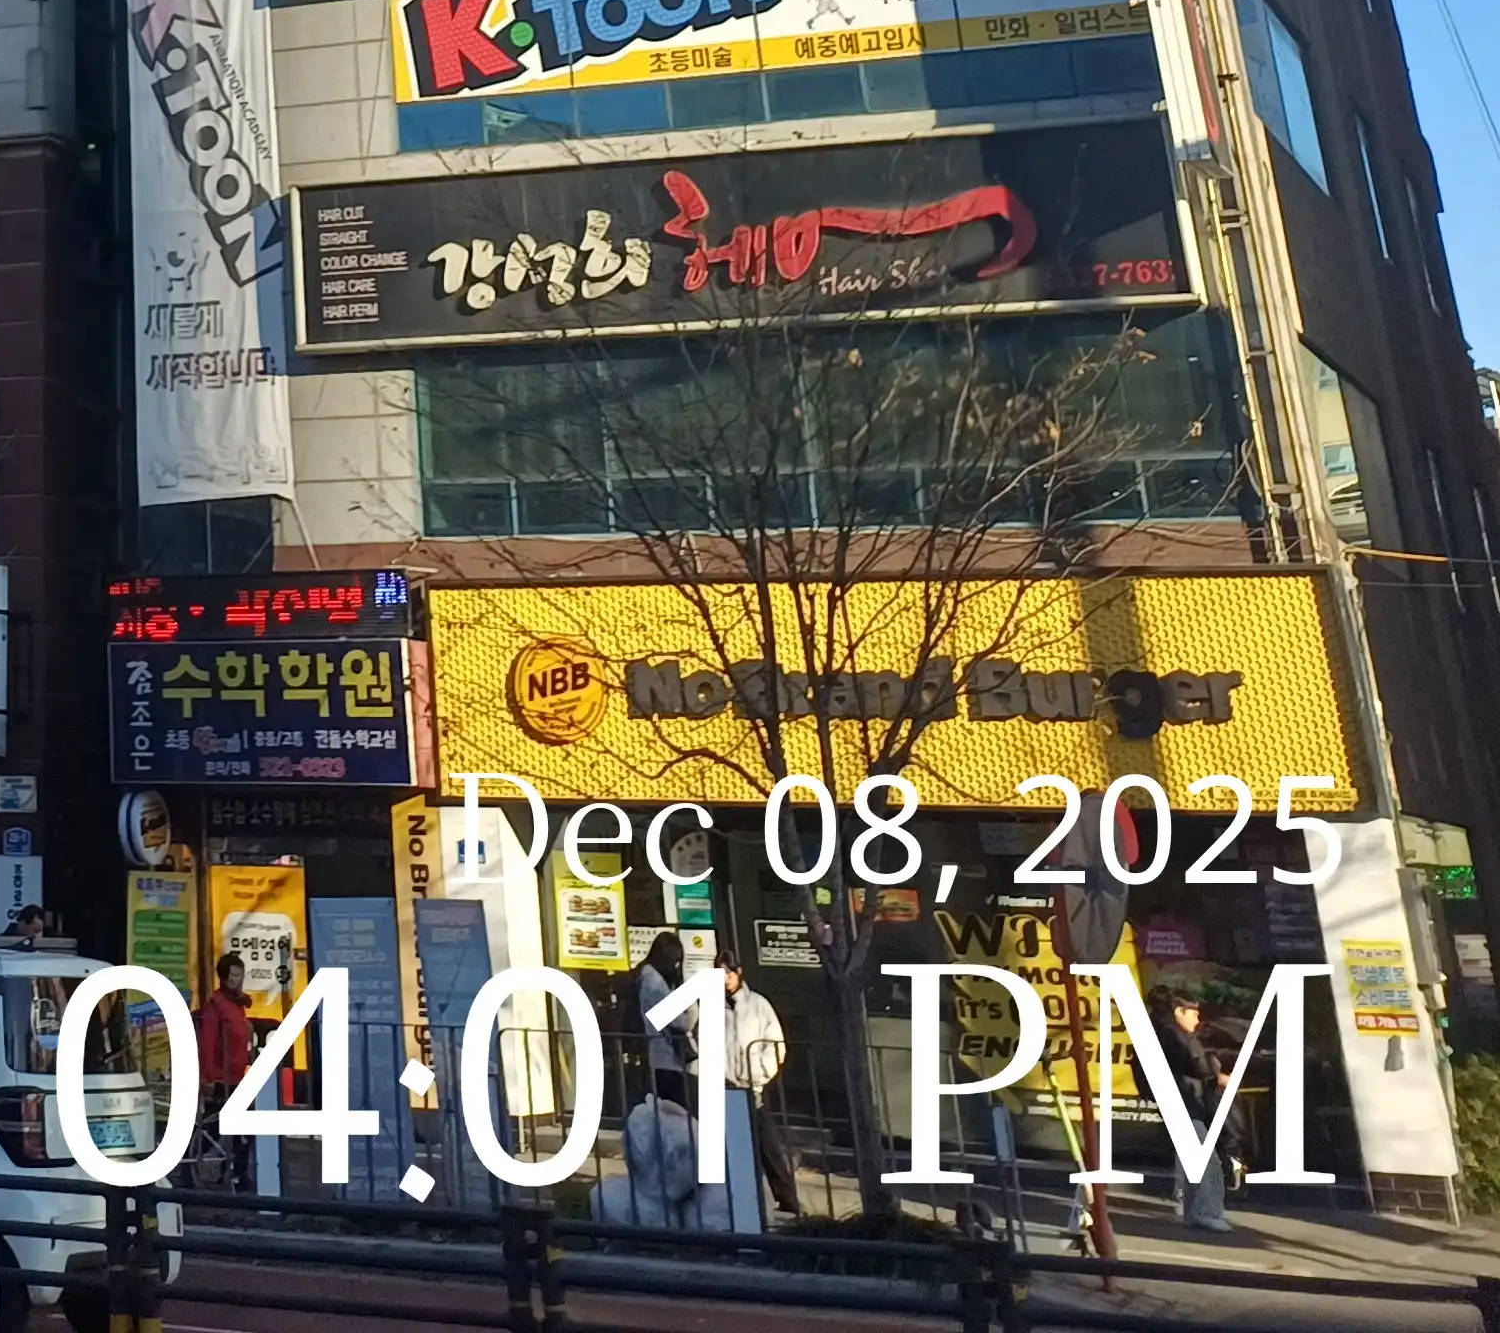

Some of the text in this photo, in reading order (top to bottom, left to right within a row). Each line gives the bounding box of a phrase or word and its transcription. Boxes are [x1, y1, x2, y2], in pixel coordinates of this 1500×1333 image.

[648, 46, 733, 74] 초등미술
[793, 23, 928, 60] 예중예고입시
[985, 14, 1031, 43] 만화
[320, 250, 409, 271] COLOR CHANGE
[818, 264, 883, 297] Hair
[321, 277, 377, 295] HAIR CARE
[145, 346, 278, 392] 시작합니다
[162, 648, 395, 719] 수학학원
[527, 662, 591, 703] NBB
